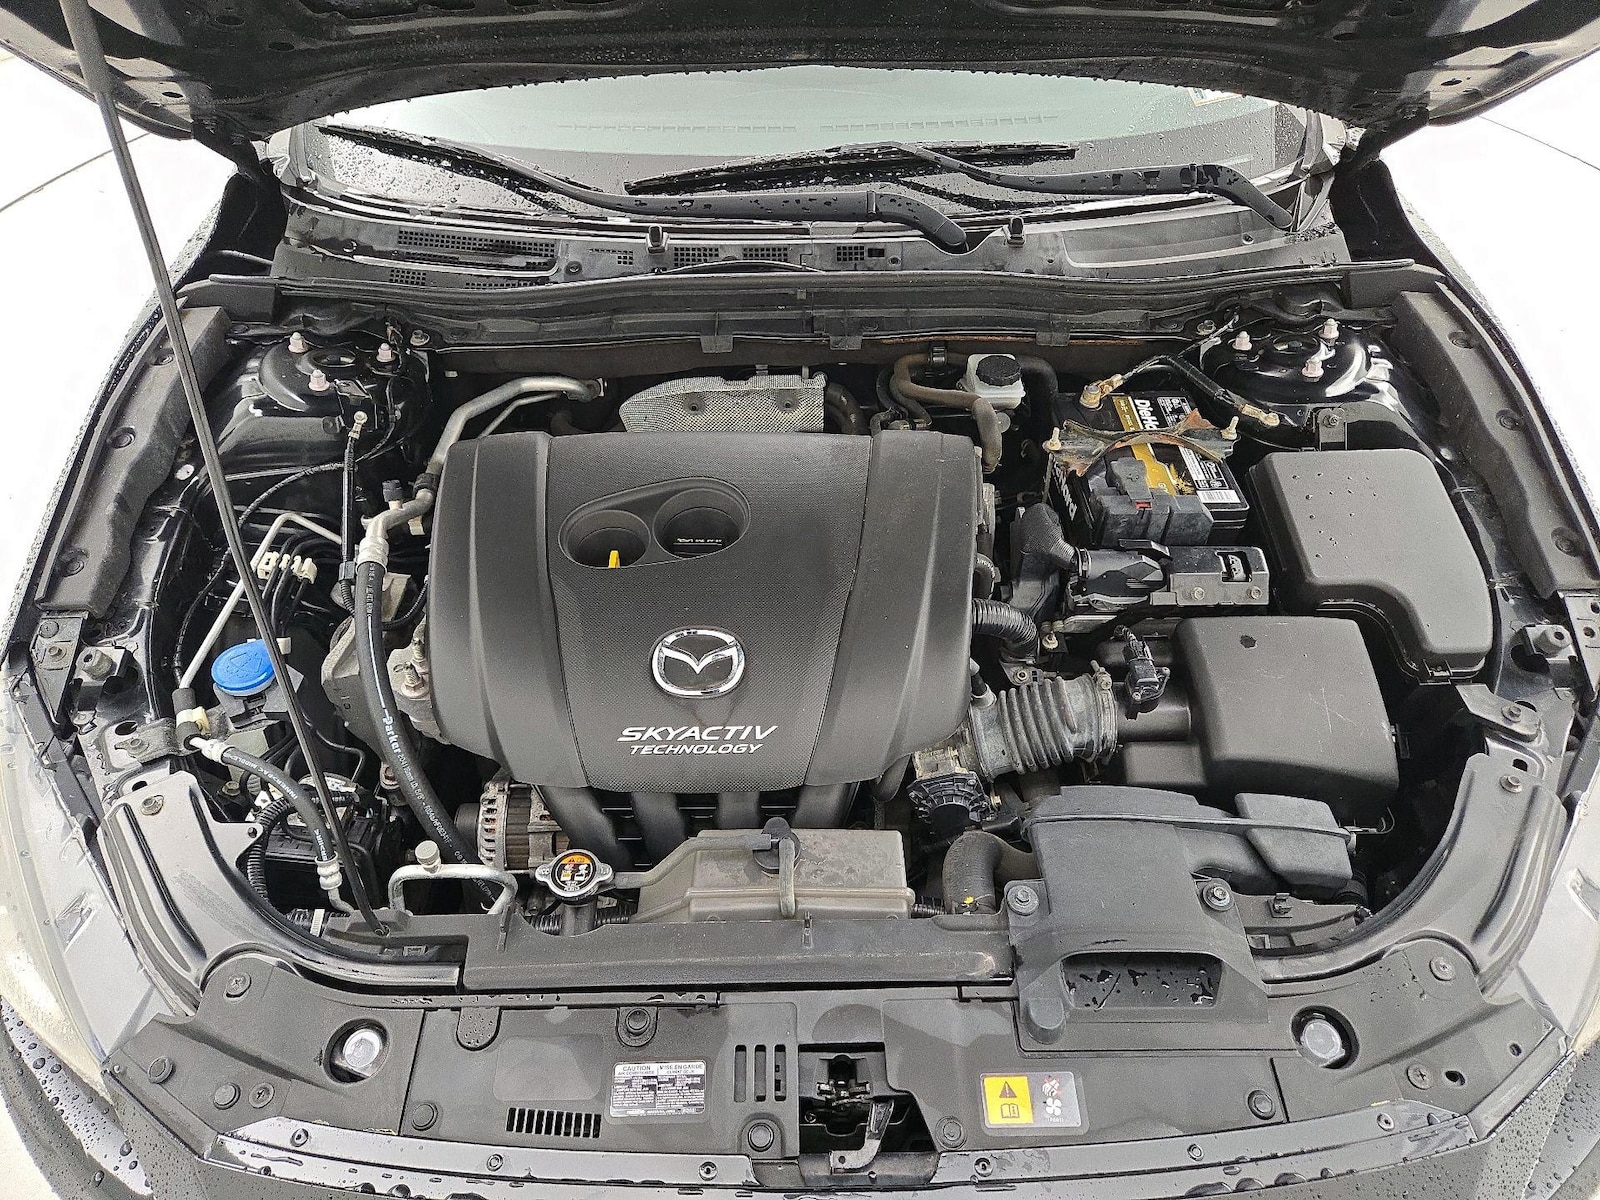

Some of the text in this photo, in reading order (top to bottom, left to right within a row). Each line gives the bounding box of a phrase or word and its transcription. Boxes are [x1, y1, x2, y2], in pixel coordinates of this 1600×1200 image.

[1134, 399, 1159, 431] DieHa
[382, 716, 401, 753] Parker
[617, 725, 779, 742] SKYACTIV
[630, 743, 764, 755] TECHNOLOGY
